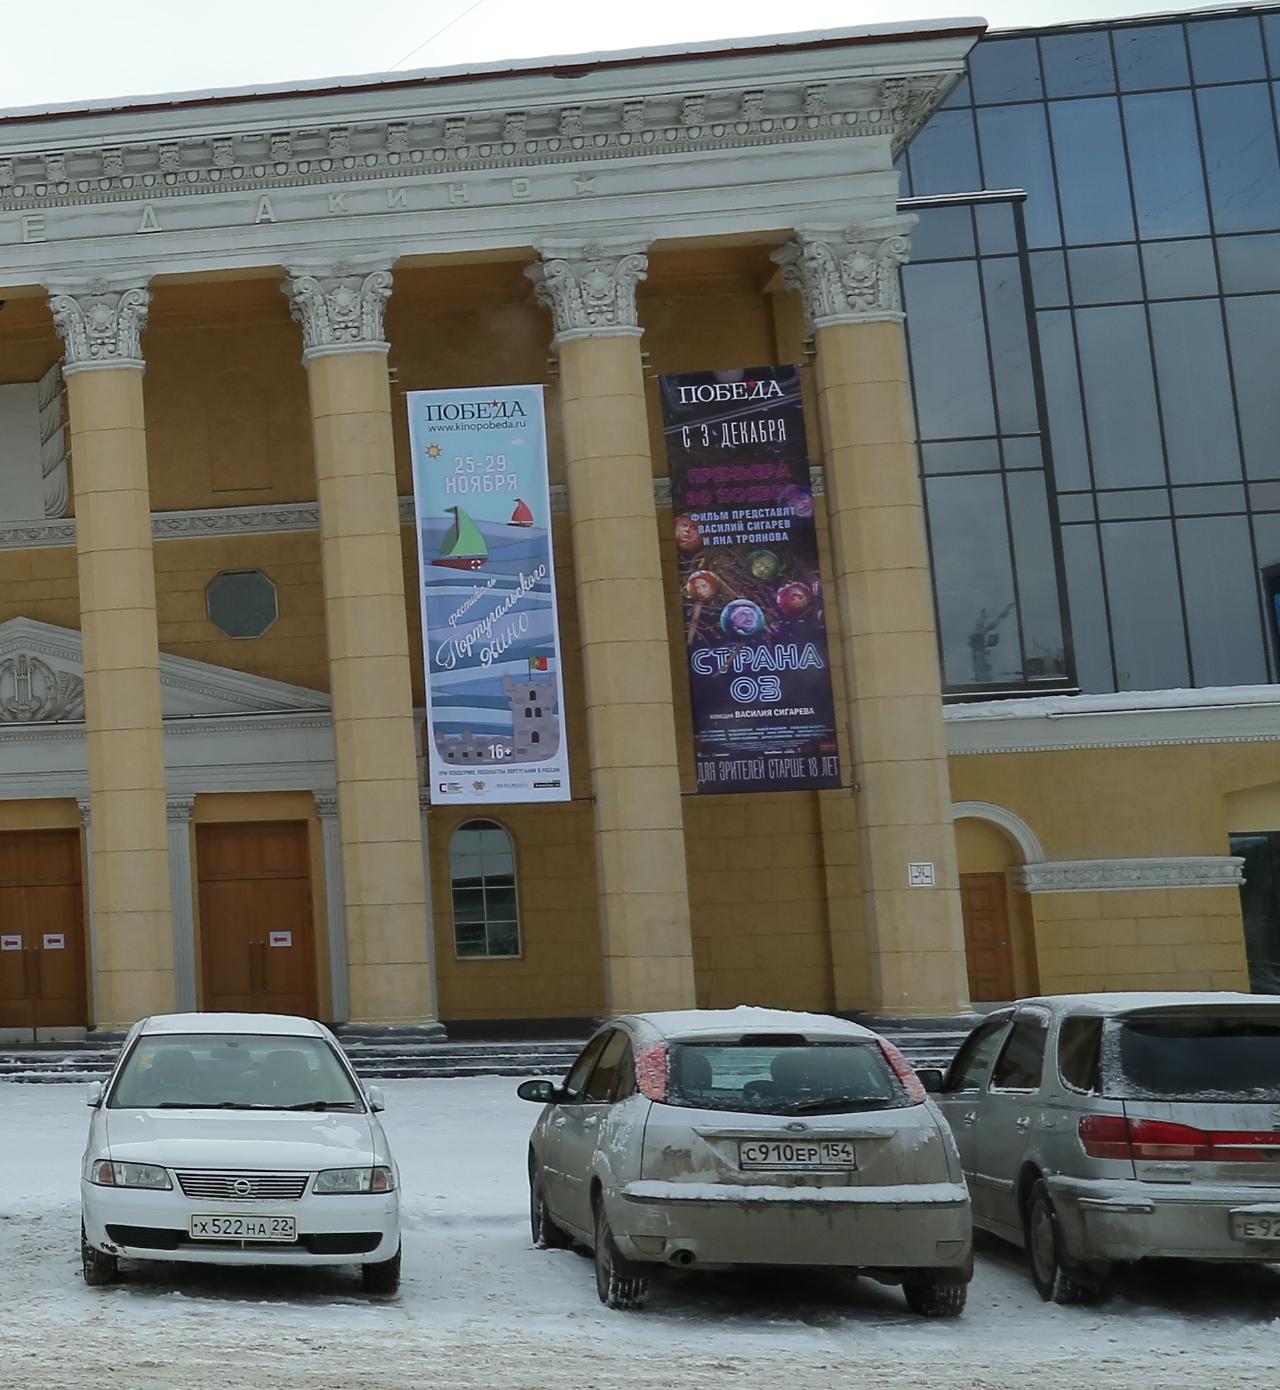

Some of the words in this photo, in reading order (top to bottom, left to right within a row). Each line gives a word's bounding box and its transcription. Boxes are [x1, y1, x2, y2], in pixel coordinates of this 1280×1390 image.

[327, 178, 531, 213] КИНО
[678, 379, 784, 404] ПОБЕДА
[425, 400, 527, 422] ПОБЕДА
[428, 420, 526, 433] www.kinopobeda.ru
[682, 426, 690, 448] С
[701, 424, 709, 447] 3
[721, 419, 786, 448] ДЕКАБРЯ
[454, 455, 507, 474] 25-29
[445, 474, 518, 494] НОЯБРЯ
[690, 511, 729, 521] ФИЛЬМ
[732, 506, 795, 520] ПРЕДСТАВЯТ
[698, 520, 744, 534] ВАСИЛИЙ
[747, 520, 791, 532] СИГАРЕВ
[703, 538, 710, 546] И
[713, 536, 733, 546] ЯНА
[736, 532, 790, 544] ТРОЯНОВА
[448, 579, 496, 628] фестиваль
[436, 564, 546, 669] Португальского
[692, 643, 824, 675] СТРАНА
[735, 710, 772, 718] ВАСИЛИЯ
[773, 707, 816, 716] СИГАРЕВА
[488, 744, 512, 759] 16+
[697, 762, 716, 784] ДЛЯ
[719, 757, 765, 782] ЗРИТЕЛЕЙ
[768, 758, 806, 780] СТАРШЕ
[808, 758, 818, 777] 18
[822, 756, 838, 777] ЛЕТ
[272, 1220, 288, 1232] 22
